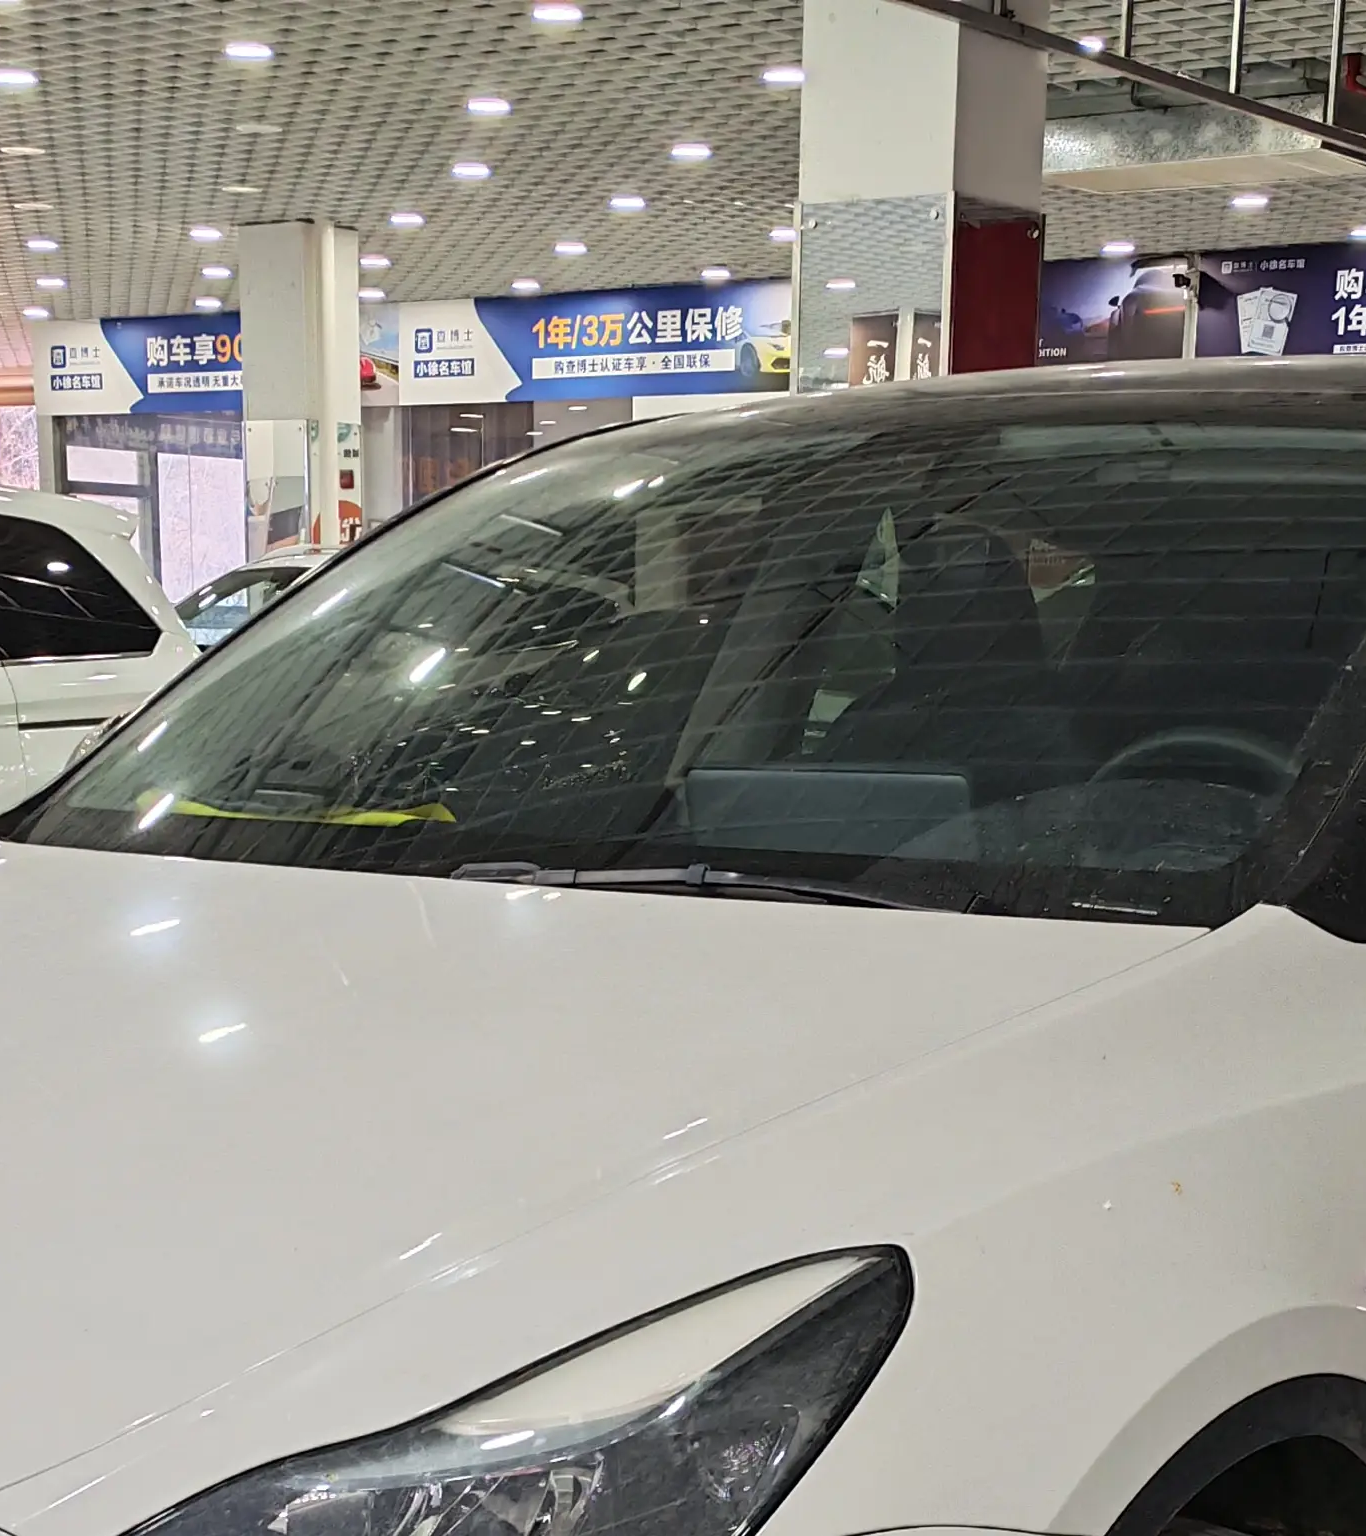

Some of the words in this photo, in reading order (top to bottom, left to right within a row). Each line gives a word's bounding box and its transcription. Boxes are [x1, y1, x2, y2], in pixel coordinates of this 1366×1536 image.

[532, 306, 744, 349] 1年/3万公里保修
[416, 361, 473, 376] 小徐名车馆
[53, 375, 101, 389] 小徐名车馆
[213, 374, 243, 387] 无重大
